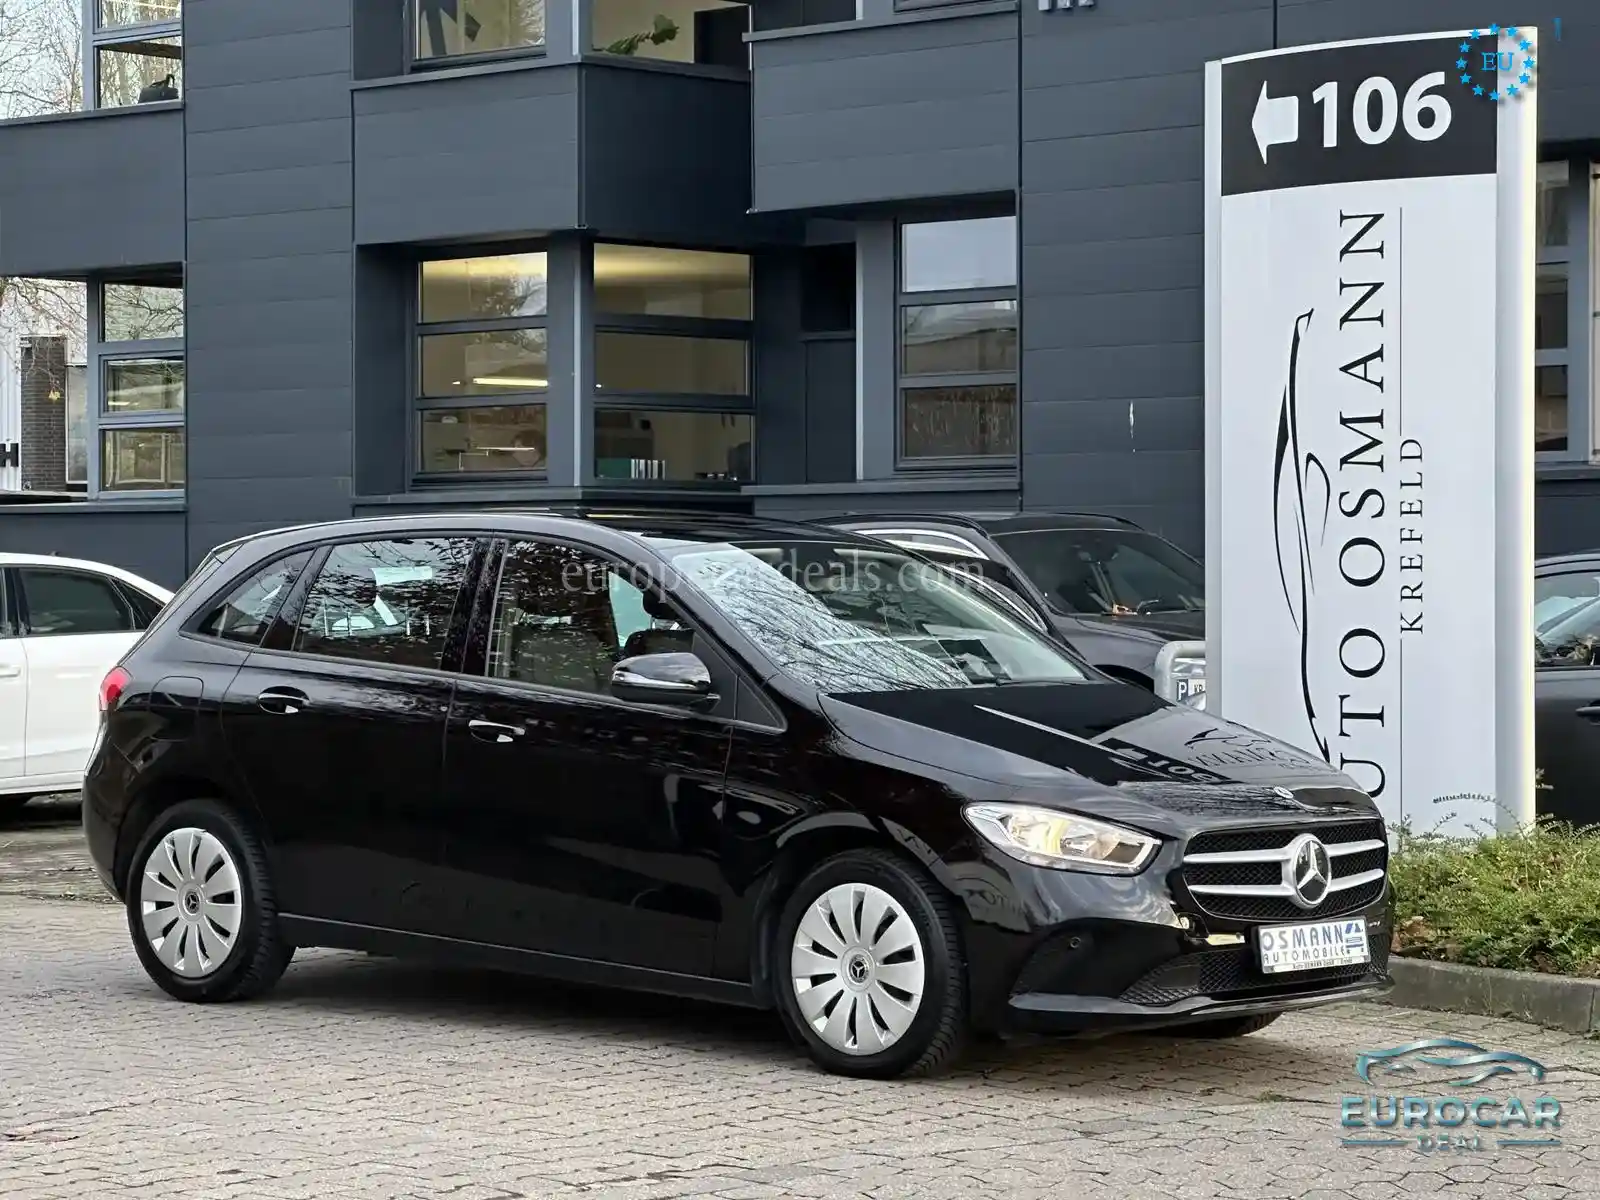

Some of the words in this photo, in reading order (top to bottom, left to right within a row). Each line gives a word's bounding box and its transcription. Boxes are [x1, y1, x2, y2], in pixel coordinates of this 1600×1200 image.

[1312, 71, 1452, 148] 106
[1338, 209, 1386, 588] OSMANN
[1400, 436, 1423, 634] KREFELD
[1338, 628, 1386, 798] UTO
[1261, 924, 1344, 951] OSMANN
